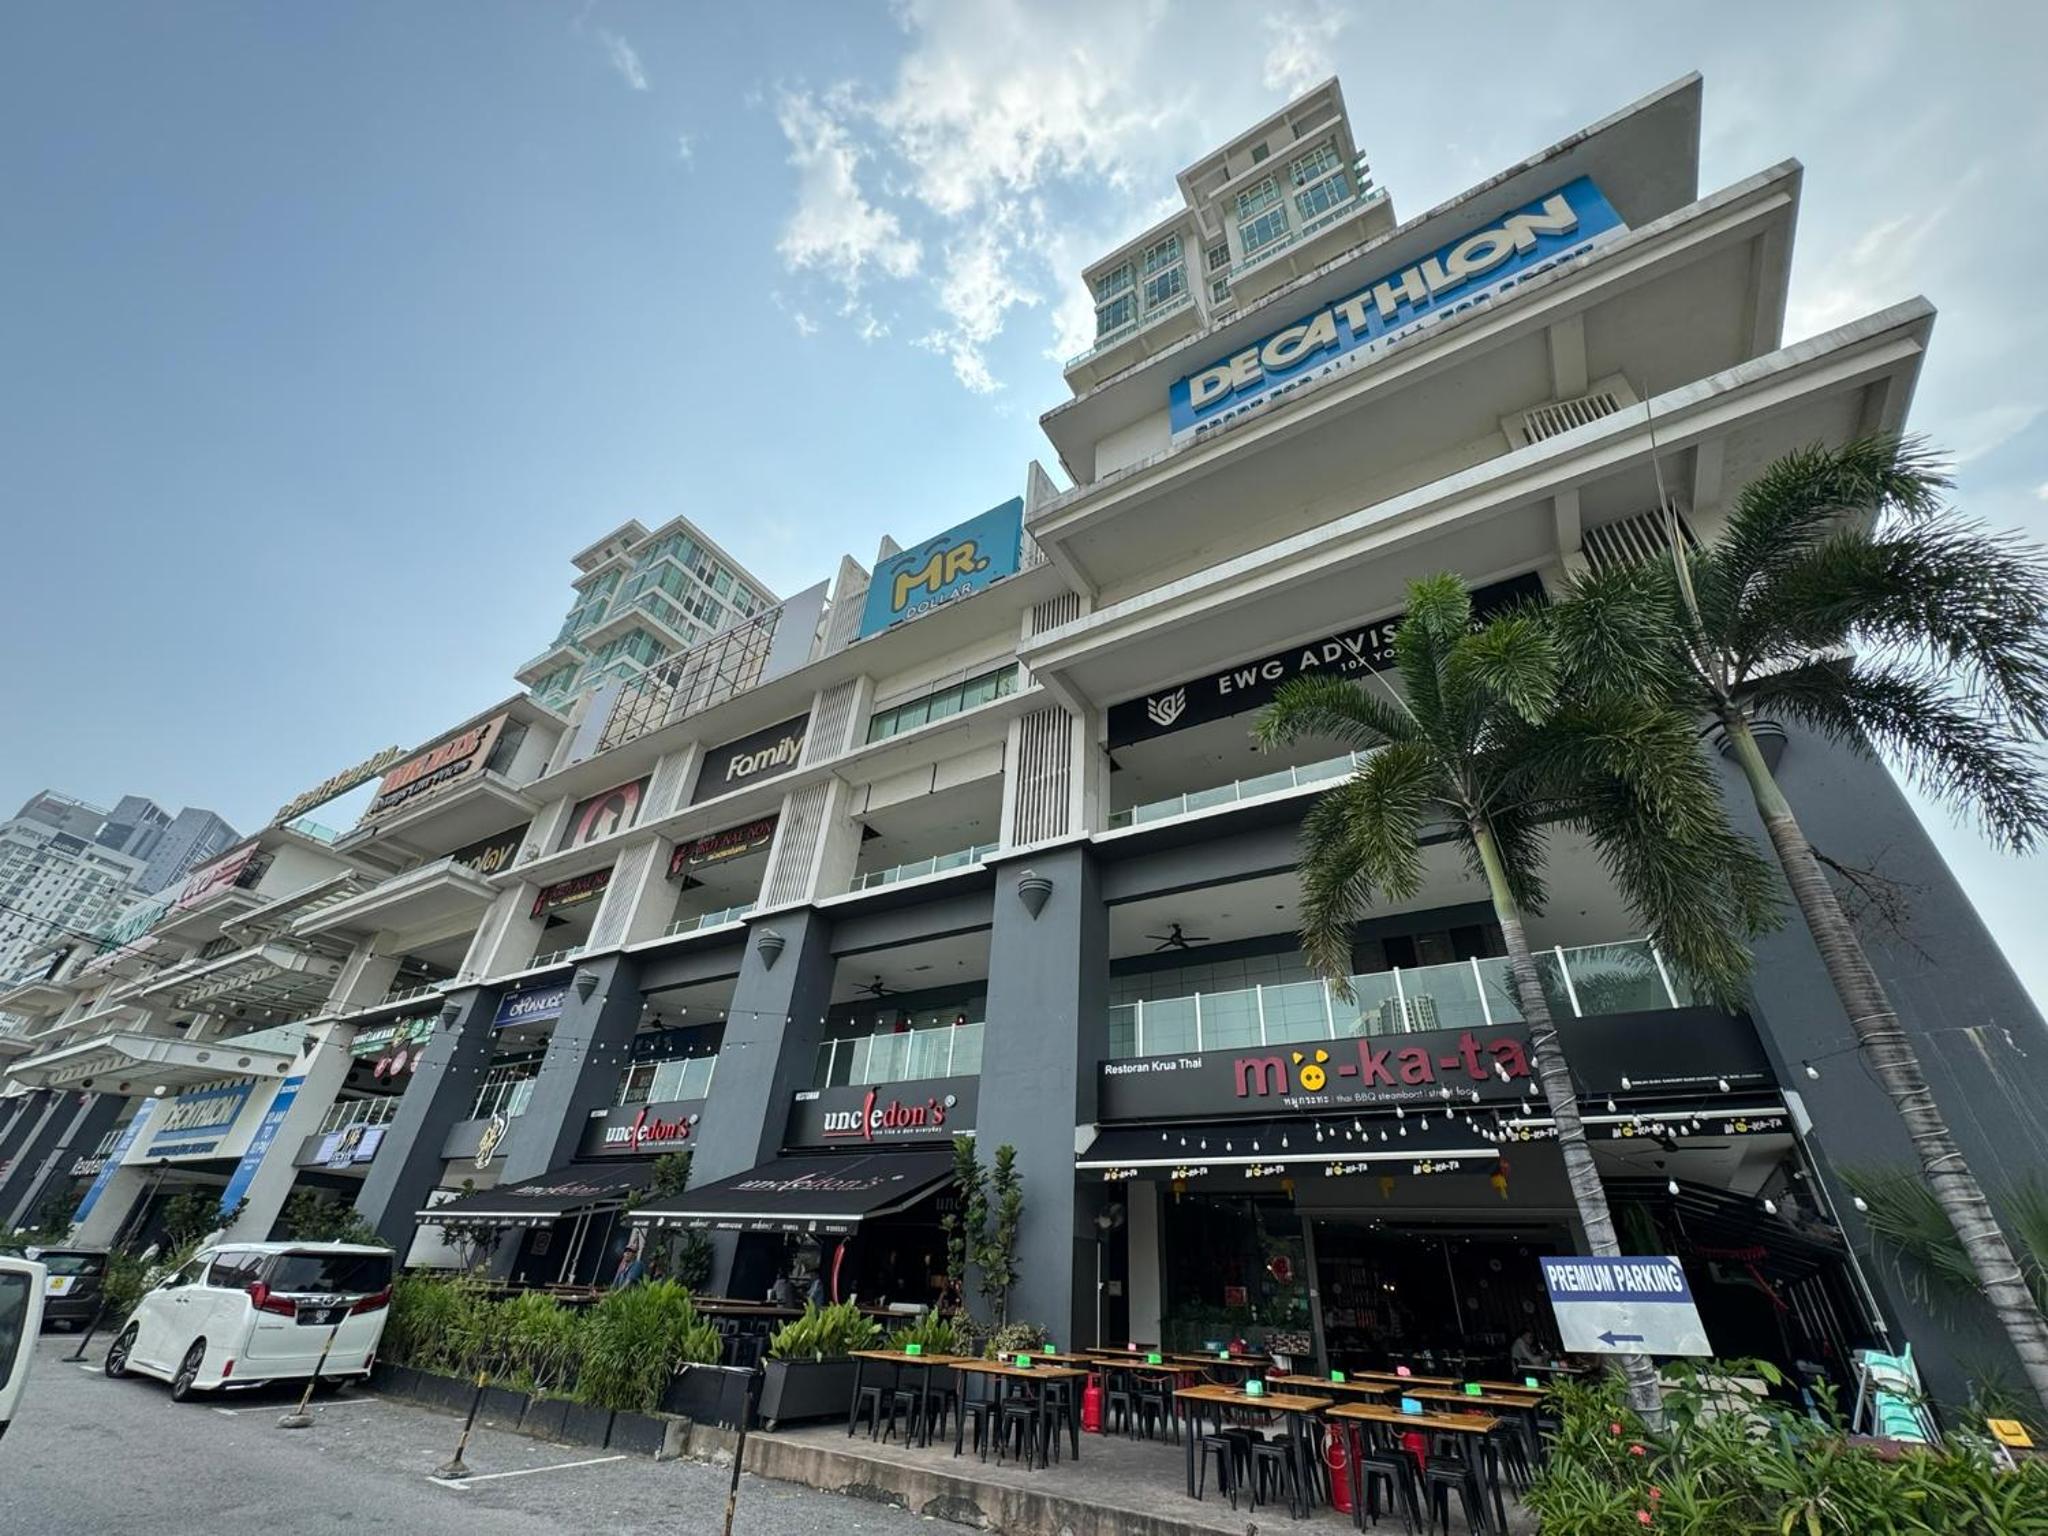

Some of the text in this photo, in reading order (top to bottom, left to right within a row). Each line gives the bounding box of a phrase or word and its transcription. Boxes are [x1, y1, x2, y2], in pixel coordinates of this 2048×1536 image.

[1190, 194, 1579, 408] DECATHLON
[1219, 659, 1285, 696] EWG
[726, 735, 804, 781] Family
[1105, 1057, 1202, 1075] Restoran Krua Thai
[1354, 1091, 1376, 1102] BBQ
[1546, 1264, 1683, 1292] PREMIUM PARKING
